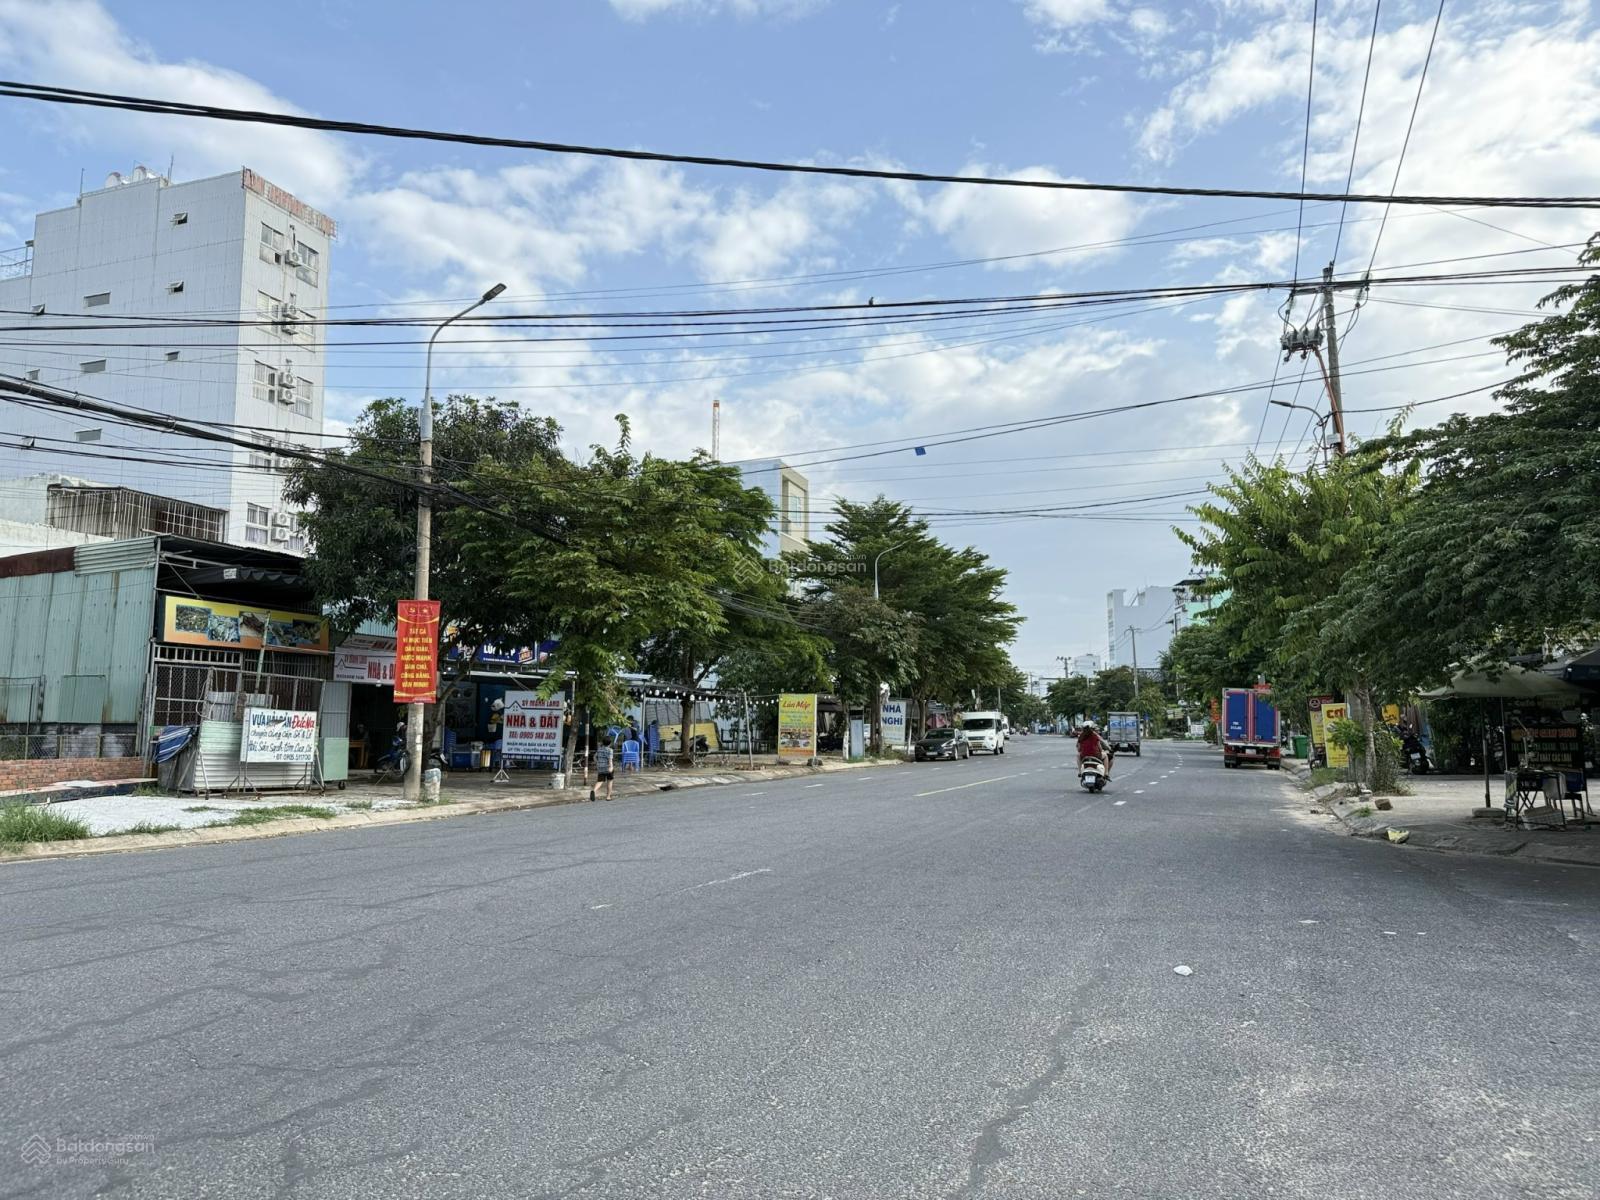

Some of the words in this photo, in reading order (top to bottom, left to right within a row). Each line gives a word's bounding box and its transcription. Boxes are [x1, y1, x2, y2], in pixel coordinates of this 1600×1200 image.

[506, 711, 526, 728] NHÀ
[529, 717, 537, 728] &
[540, 711, 560, 729] ĐẤT
